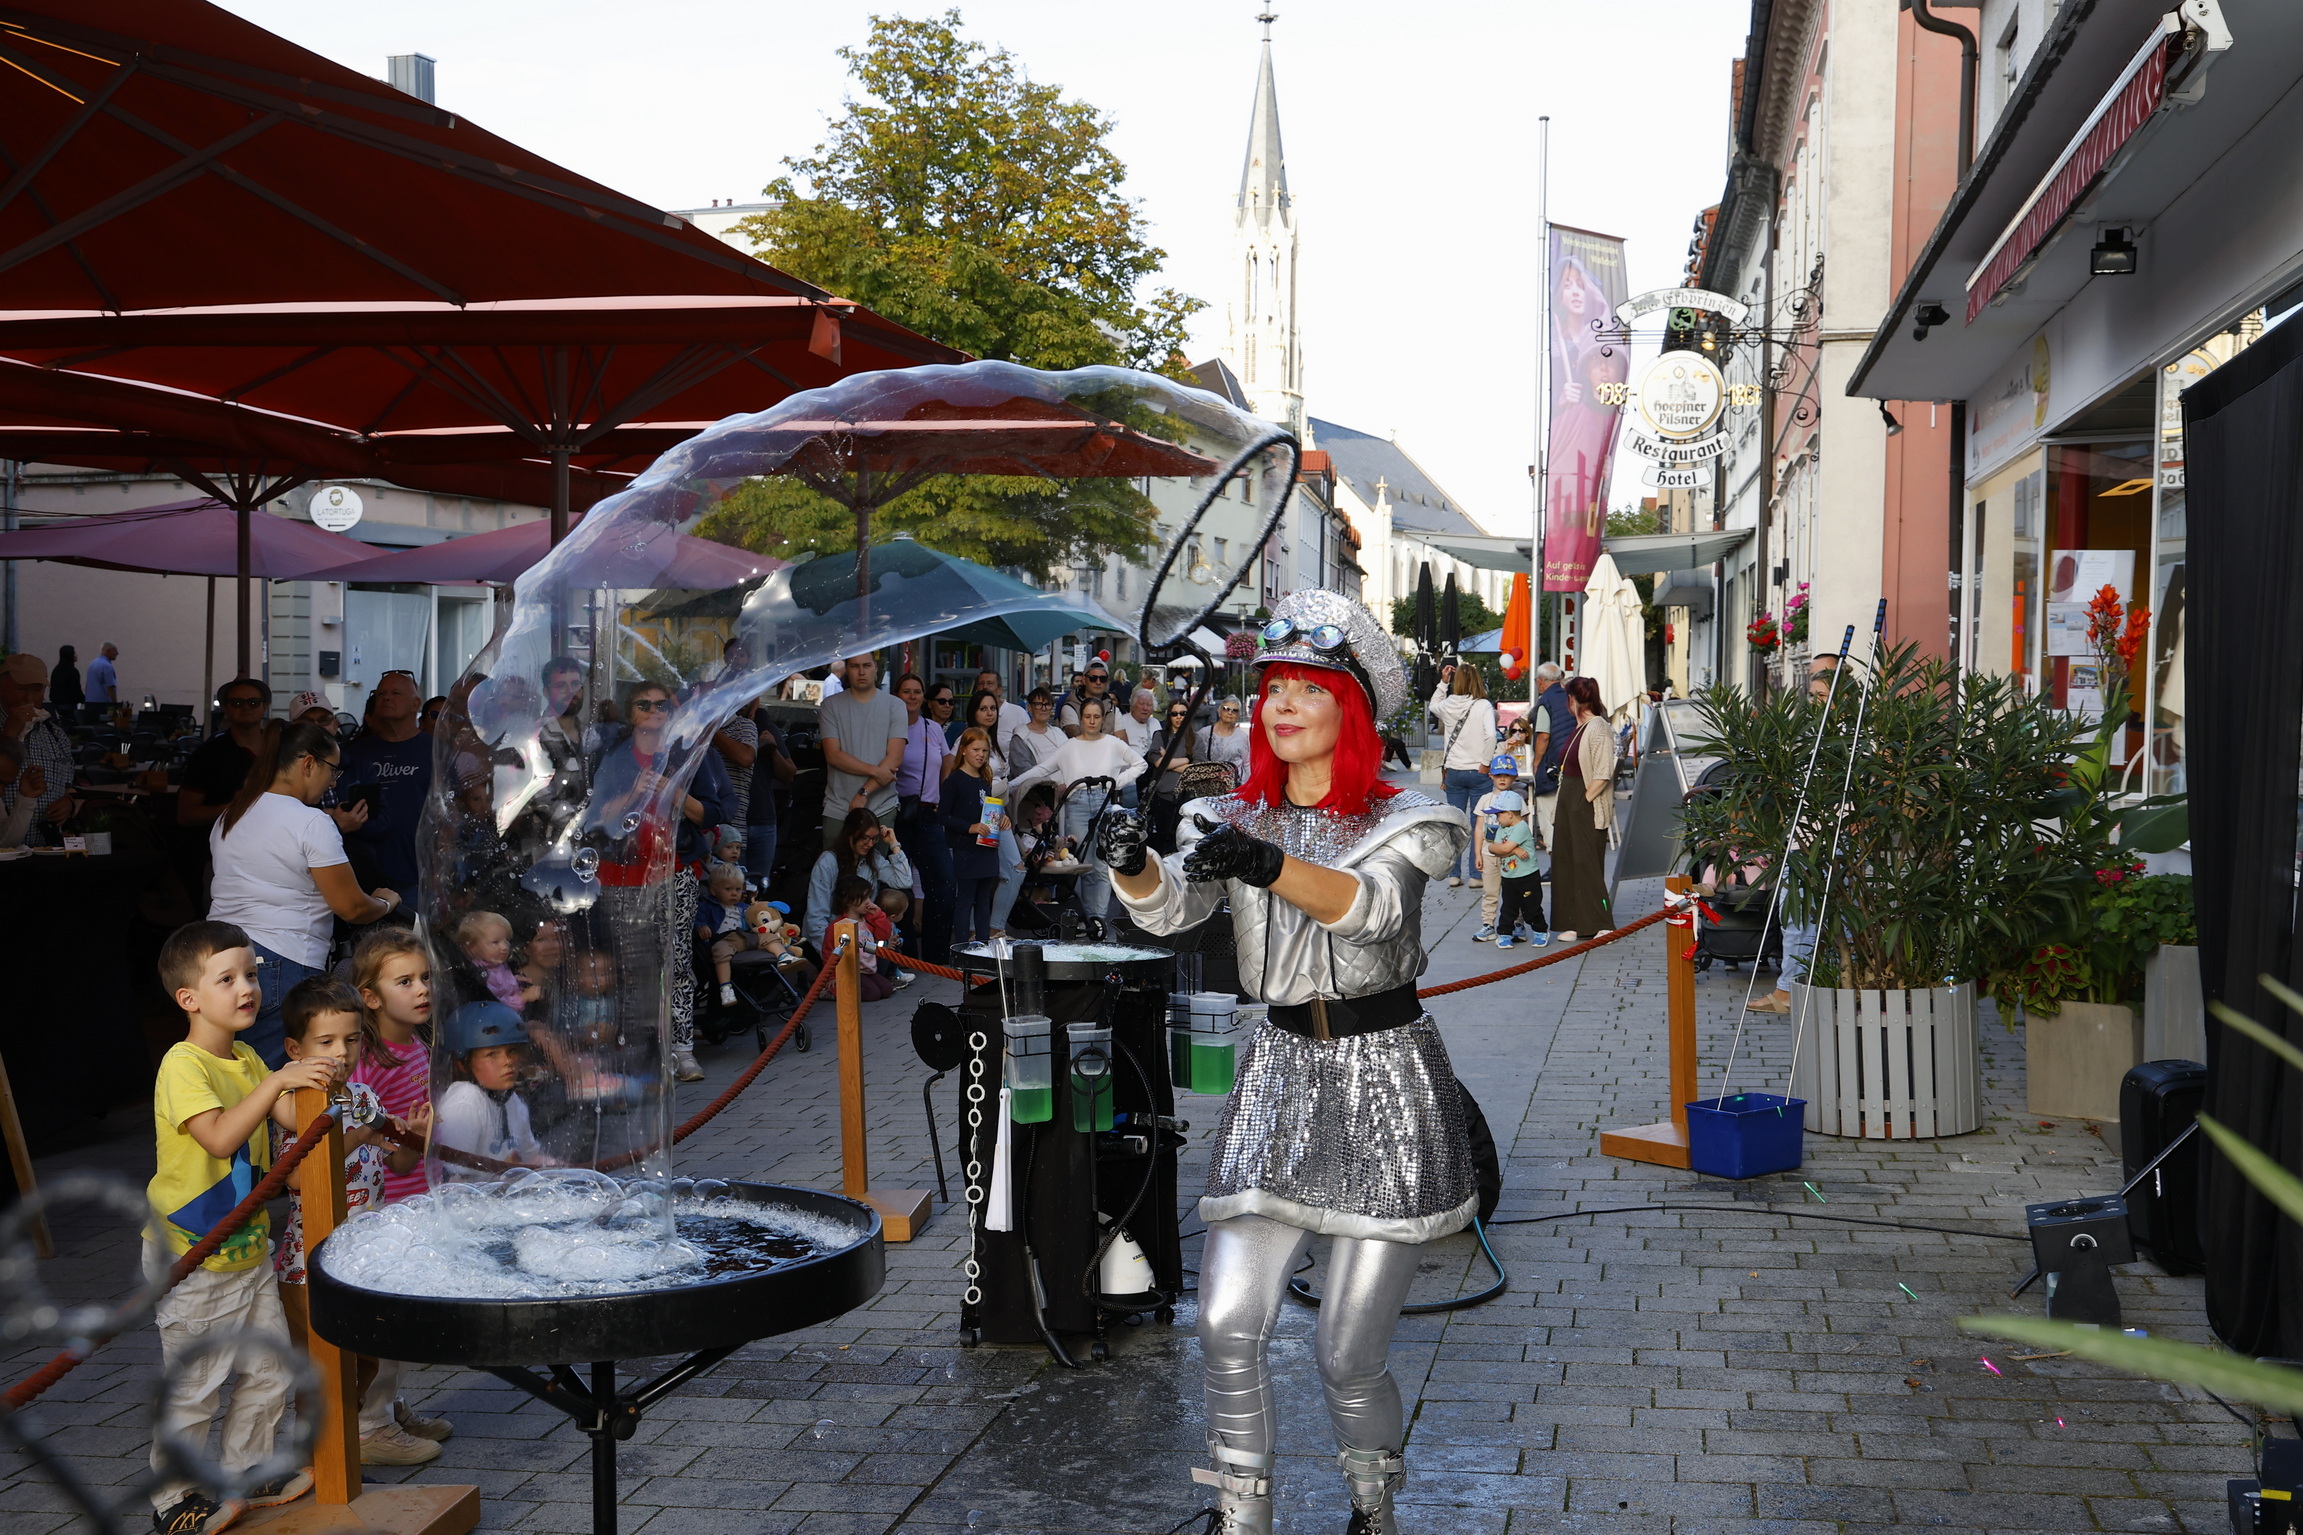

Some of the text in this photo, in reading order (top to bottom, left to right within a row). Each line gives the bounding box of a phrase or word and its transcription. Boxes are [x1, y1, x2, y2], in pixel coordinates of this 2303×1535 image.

[1662, 291, 1737, 316] Erbprinzen
[1653, 400, 1707, 413] Hoepfner
[1658, 413, 1702, 425] Pilsner
[1632, 436, 1724, 461] Restaurant
[1657, 470, 1697, 486] Hotel
[1546, 561, 1561, 570] Auf
